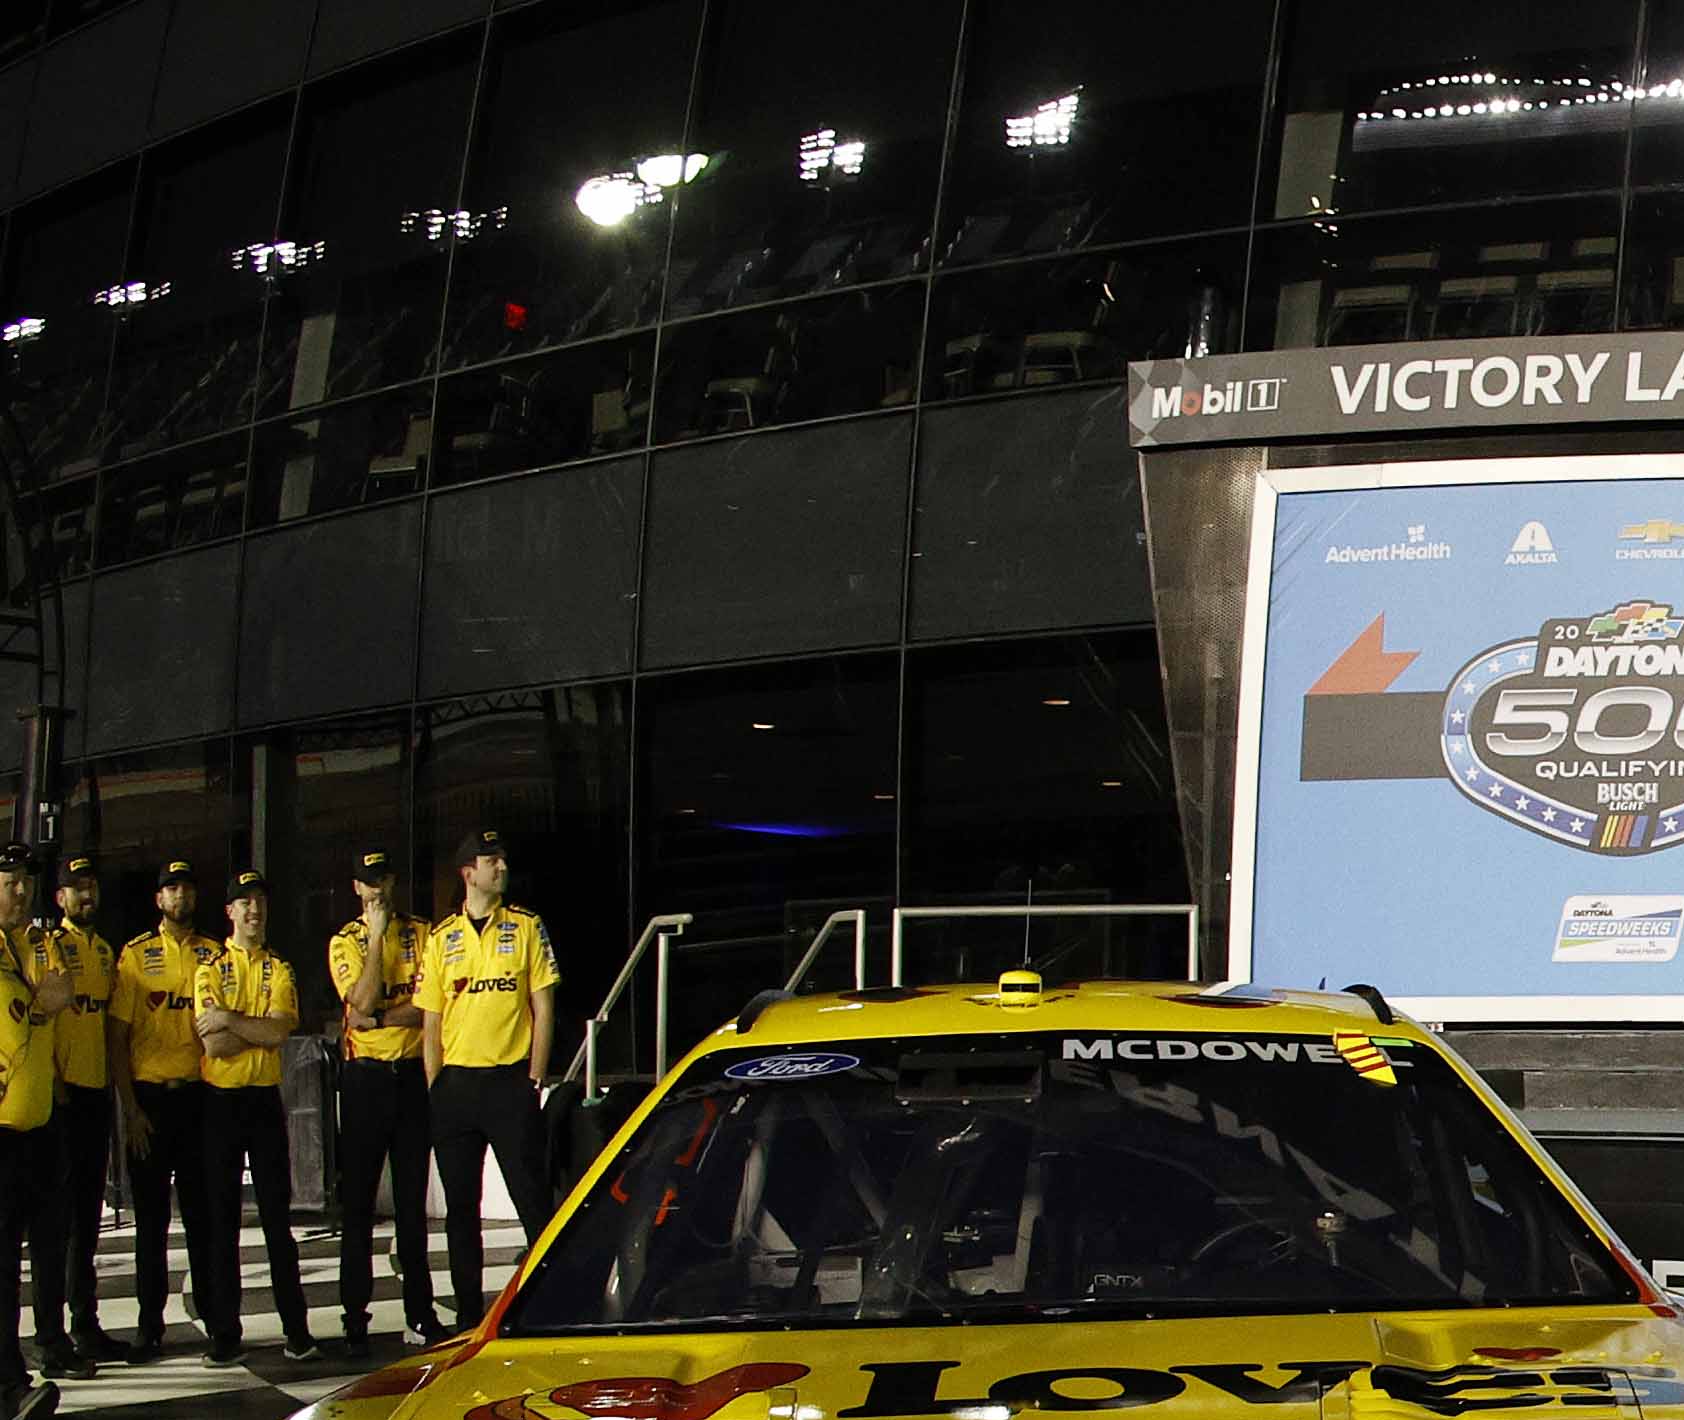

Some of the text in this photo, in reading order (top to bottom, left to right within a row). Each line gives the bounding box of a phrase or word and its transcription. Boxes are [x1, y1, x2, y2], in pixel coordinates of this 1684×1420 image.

[1331, 352, 1613, 414] VICTORY
[1152, 381, 1241, 418] Mobil
[1504, 552, 1558, 565] AXALTA
[1554, 625, 1579, 640] 20
[1598, 782, 1659, 804] BUSCH
[1609, 801, 1644, 812] LIGHT
[1567, 921, 1672, 937] SPEEDWEEKS
[745, 1056, 831, 1079] Ford
